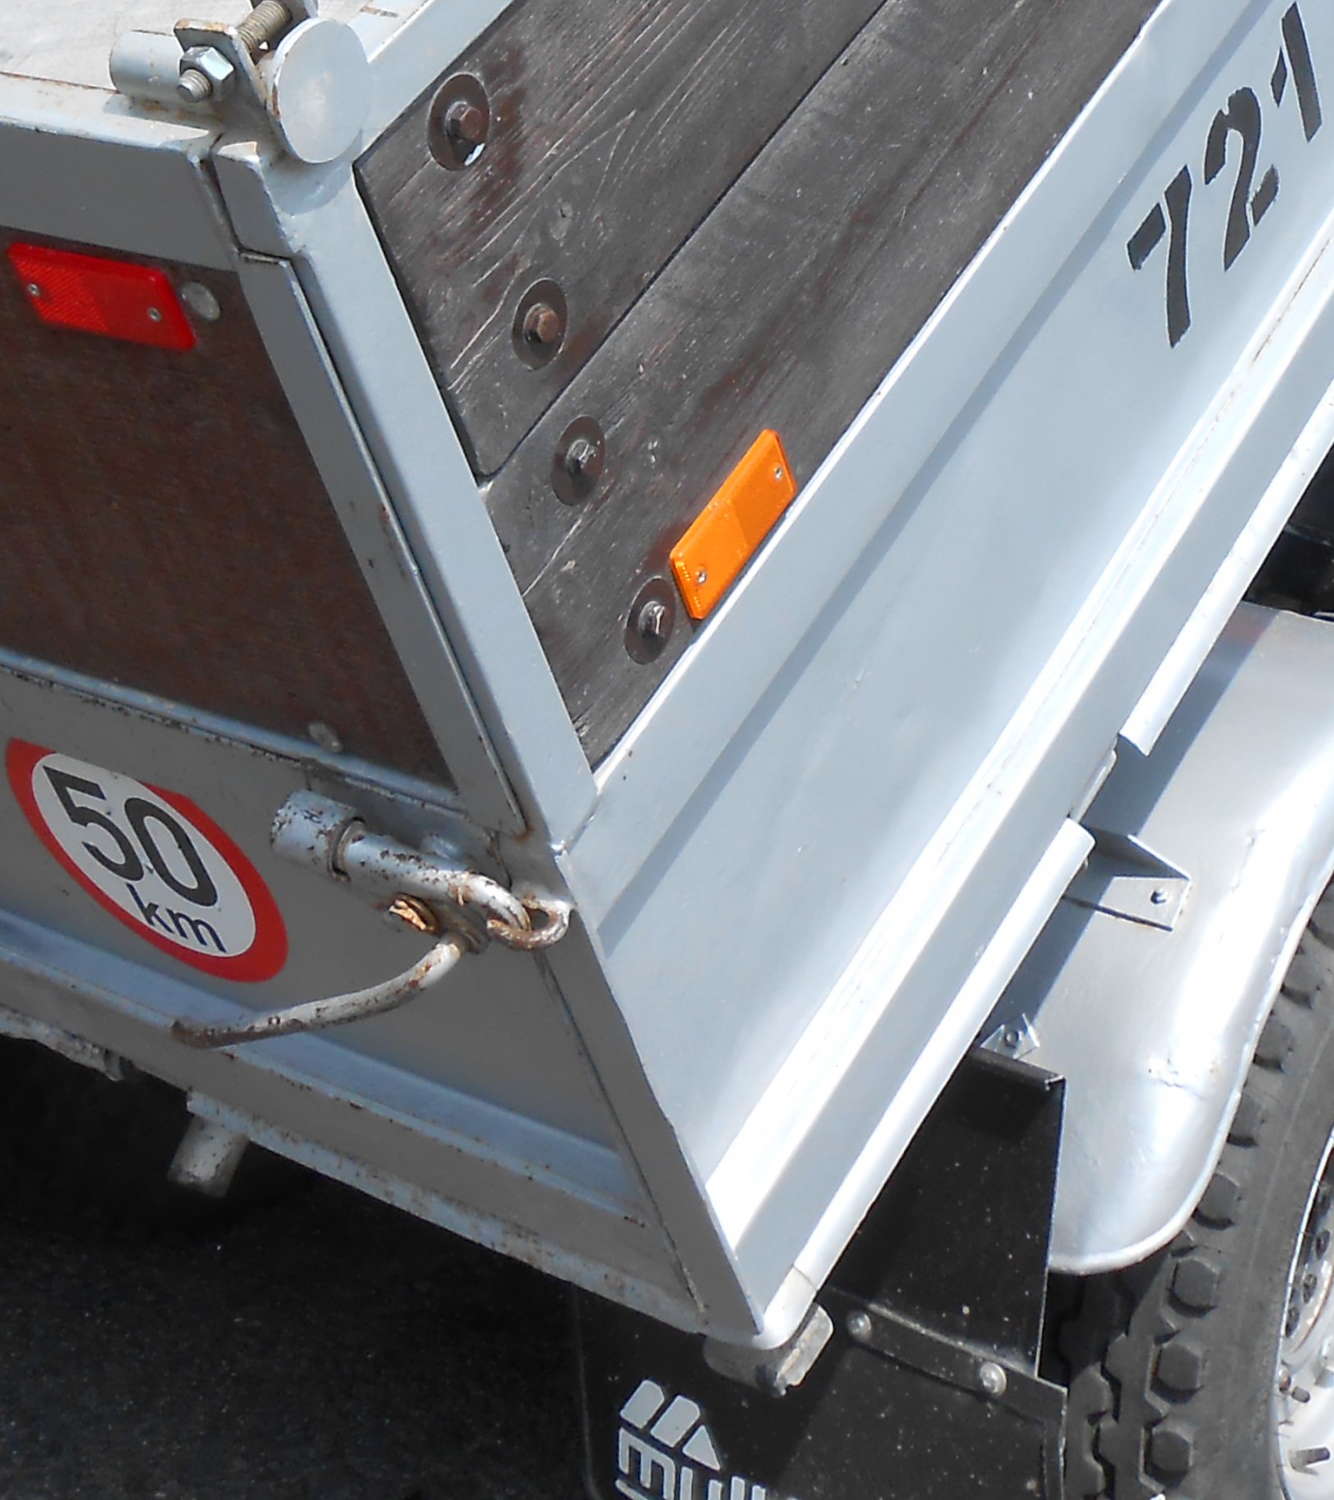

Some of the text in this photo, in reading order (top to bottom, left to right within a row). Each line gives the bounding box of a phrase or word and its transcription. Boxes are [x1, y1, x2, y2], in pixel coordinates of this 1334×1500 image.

[1126, 1, 1322, 348] 721
[42, 765, 218, 907] 50
[125, 882, 227, 954] km
